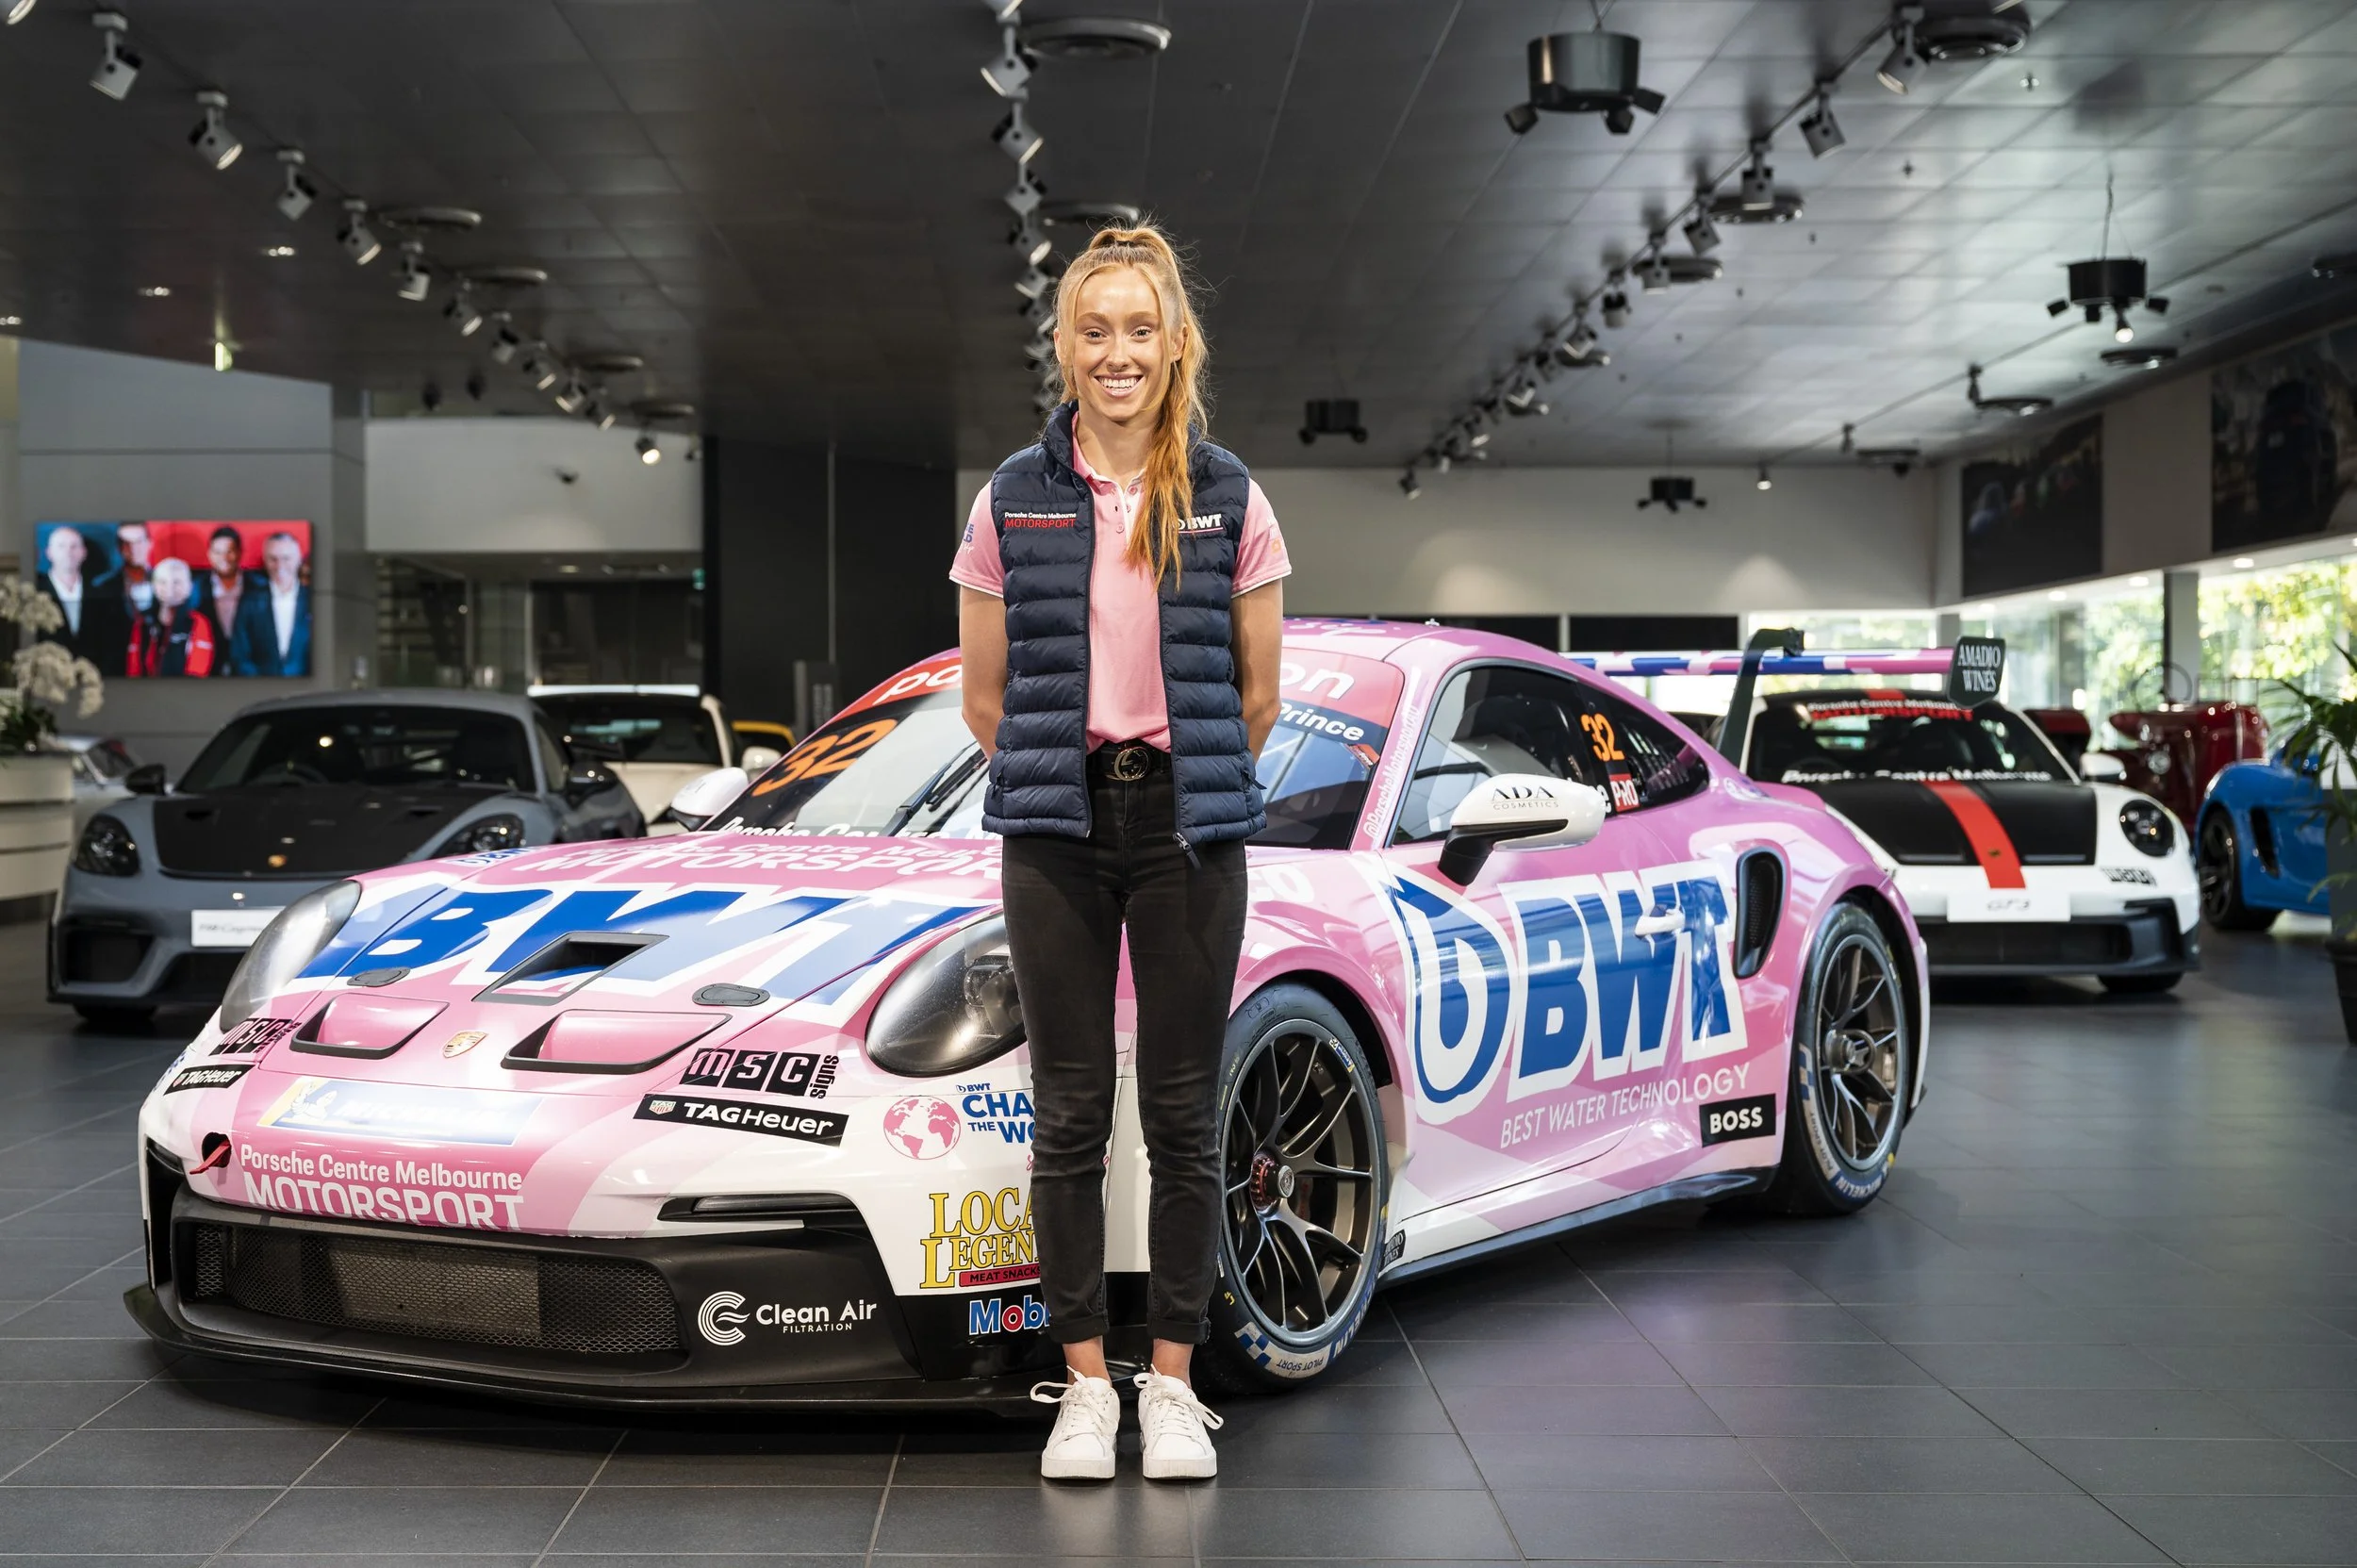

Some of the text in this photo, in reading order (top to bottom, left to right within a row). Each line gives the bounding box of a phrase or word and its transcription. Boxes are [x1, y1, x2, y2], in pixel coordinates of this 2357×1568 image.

[1005, 519, 1077, 529] MOTORSPORT
[1957, 645, 2002, 668] AMADIO
[1962, 668, 1997, 692] WINES
[1580, 713, 1625, 762] 32
[752, 718, 898, 797] 32
[1492, 785, 1555, 801] ADA
[1492, 801, 1559, 811] COSMETICS
[1610, 779, 1640, 807] PRO
[511, 850, 1002, 880] MOTORSPOR
[1508, 867, 1740, 1090] BWT
[809, 1053, 839, 1100] signs
[966, 1082, 991, 1093] BWT
[684, 1101, 834, 1136] TAGHeuer
[962, 1092, 1034, 1119] CHA
[1500, 1063, 1751, 1149] BEST WATER TECHNOLOGY
[967, 1121, 996, 1131] THE
[1709, 1107, 1763, 1134] BOSS
[240, 1144, 523, 1191] Porsche Centre Melbourne
[242, 1172, 524, 1231] MOTORSPORT
[929, 1186, 1032, 1239] LOC
[919, 1230, 1040, 1290] LEGEN
[969, 1271, 1000, 1283] MEAT
[755, 1299, 877, 1326] Clean Air
[783, 1323, 852, 1334] FILTRATION
[1276, 1359, 1302, 1371] SPORT
